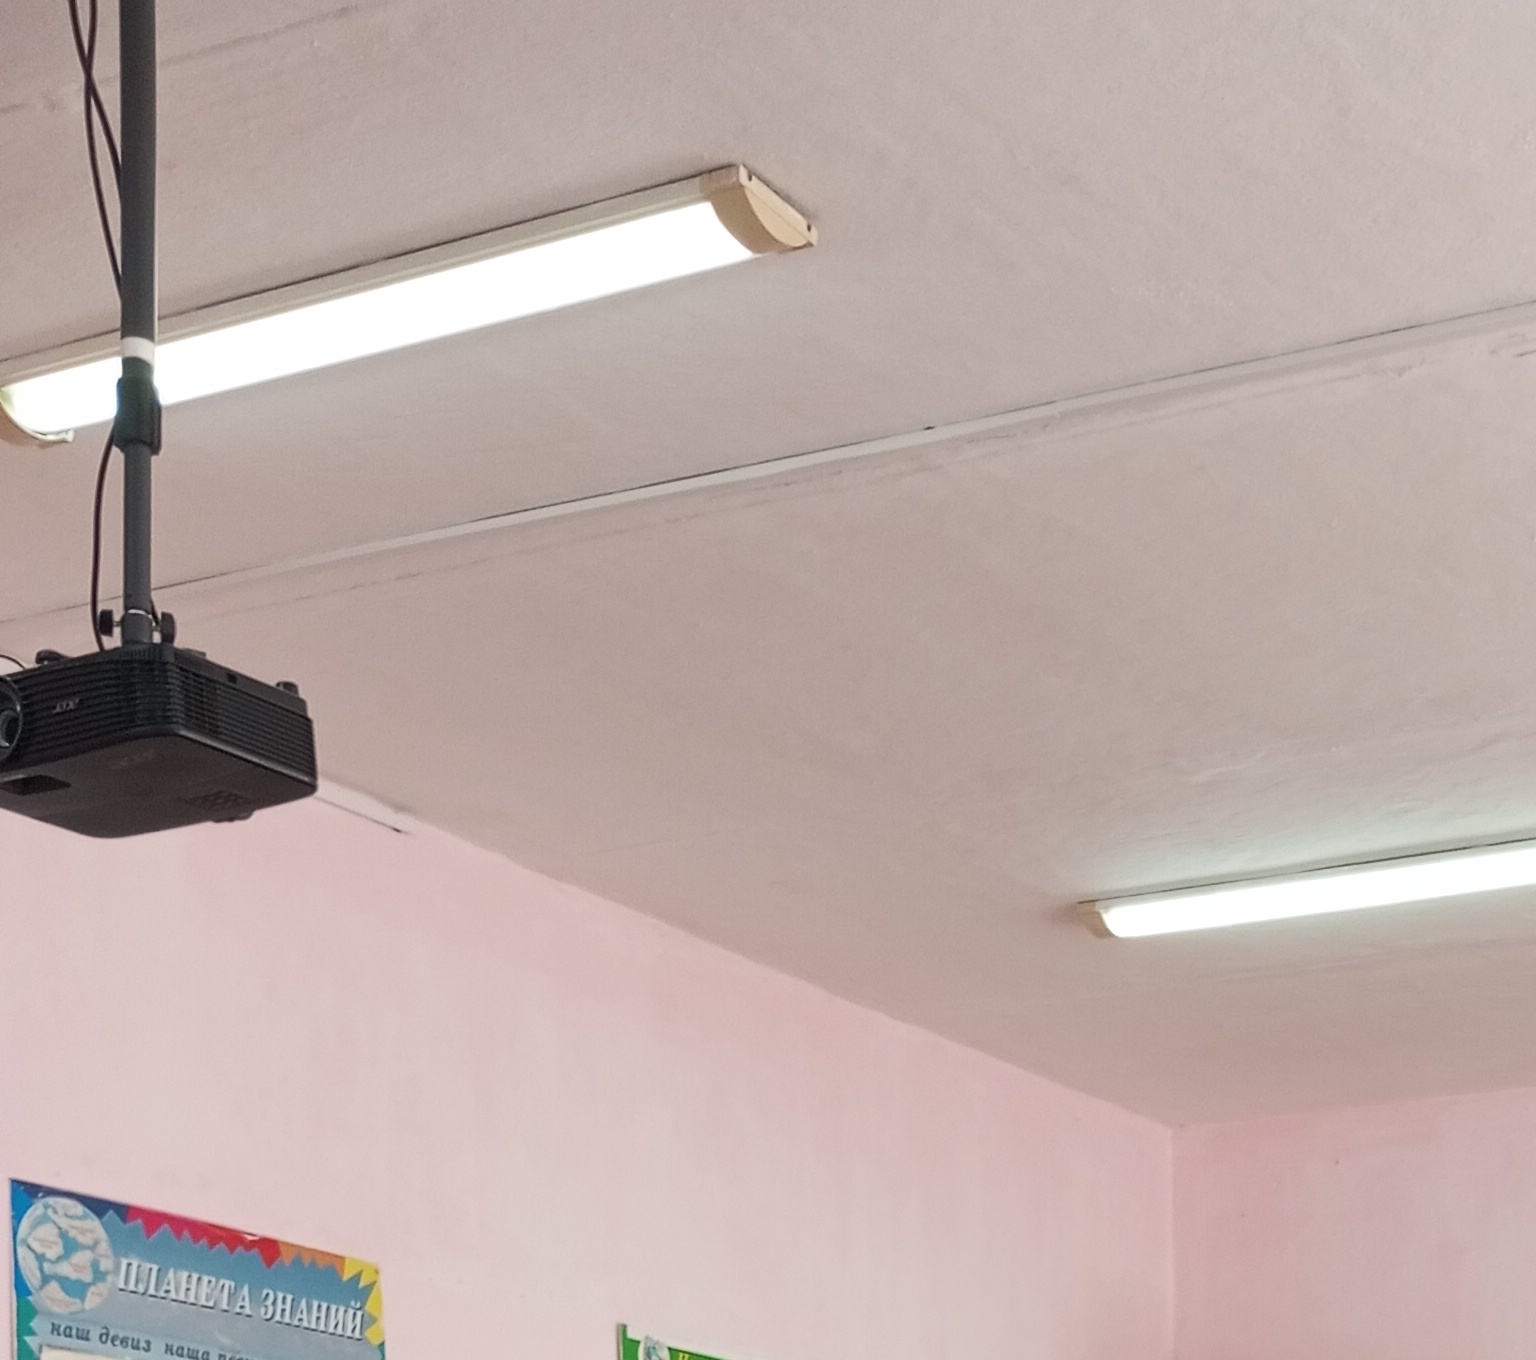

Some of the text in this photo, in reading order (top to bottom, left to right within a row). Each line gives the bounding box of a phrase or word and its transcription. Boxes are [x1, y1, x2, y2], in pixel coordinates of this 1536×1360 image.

[118, 1257, 366, 1341] ПЛАНЕТА ЗНАНИЙ
[50, 1321, 152, 1354] наш девиз
